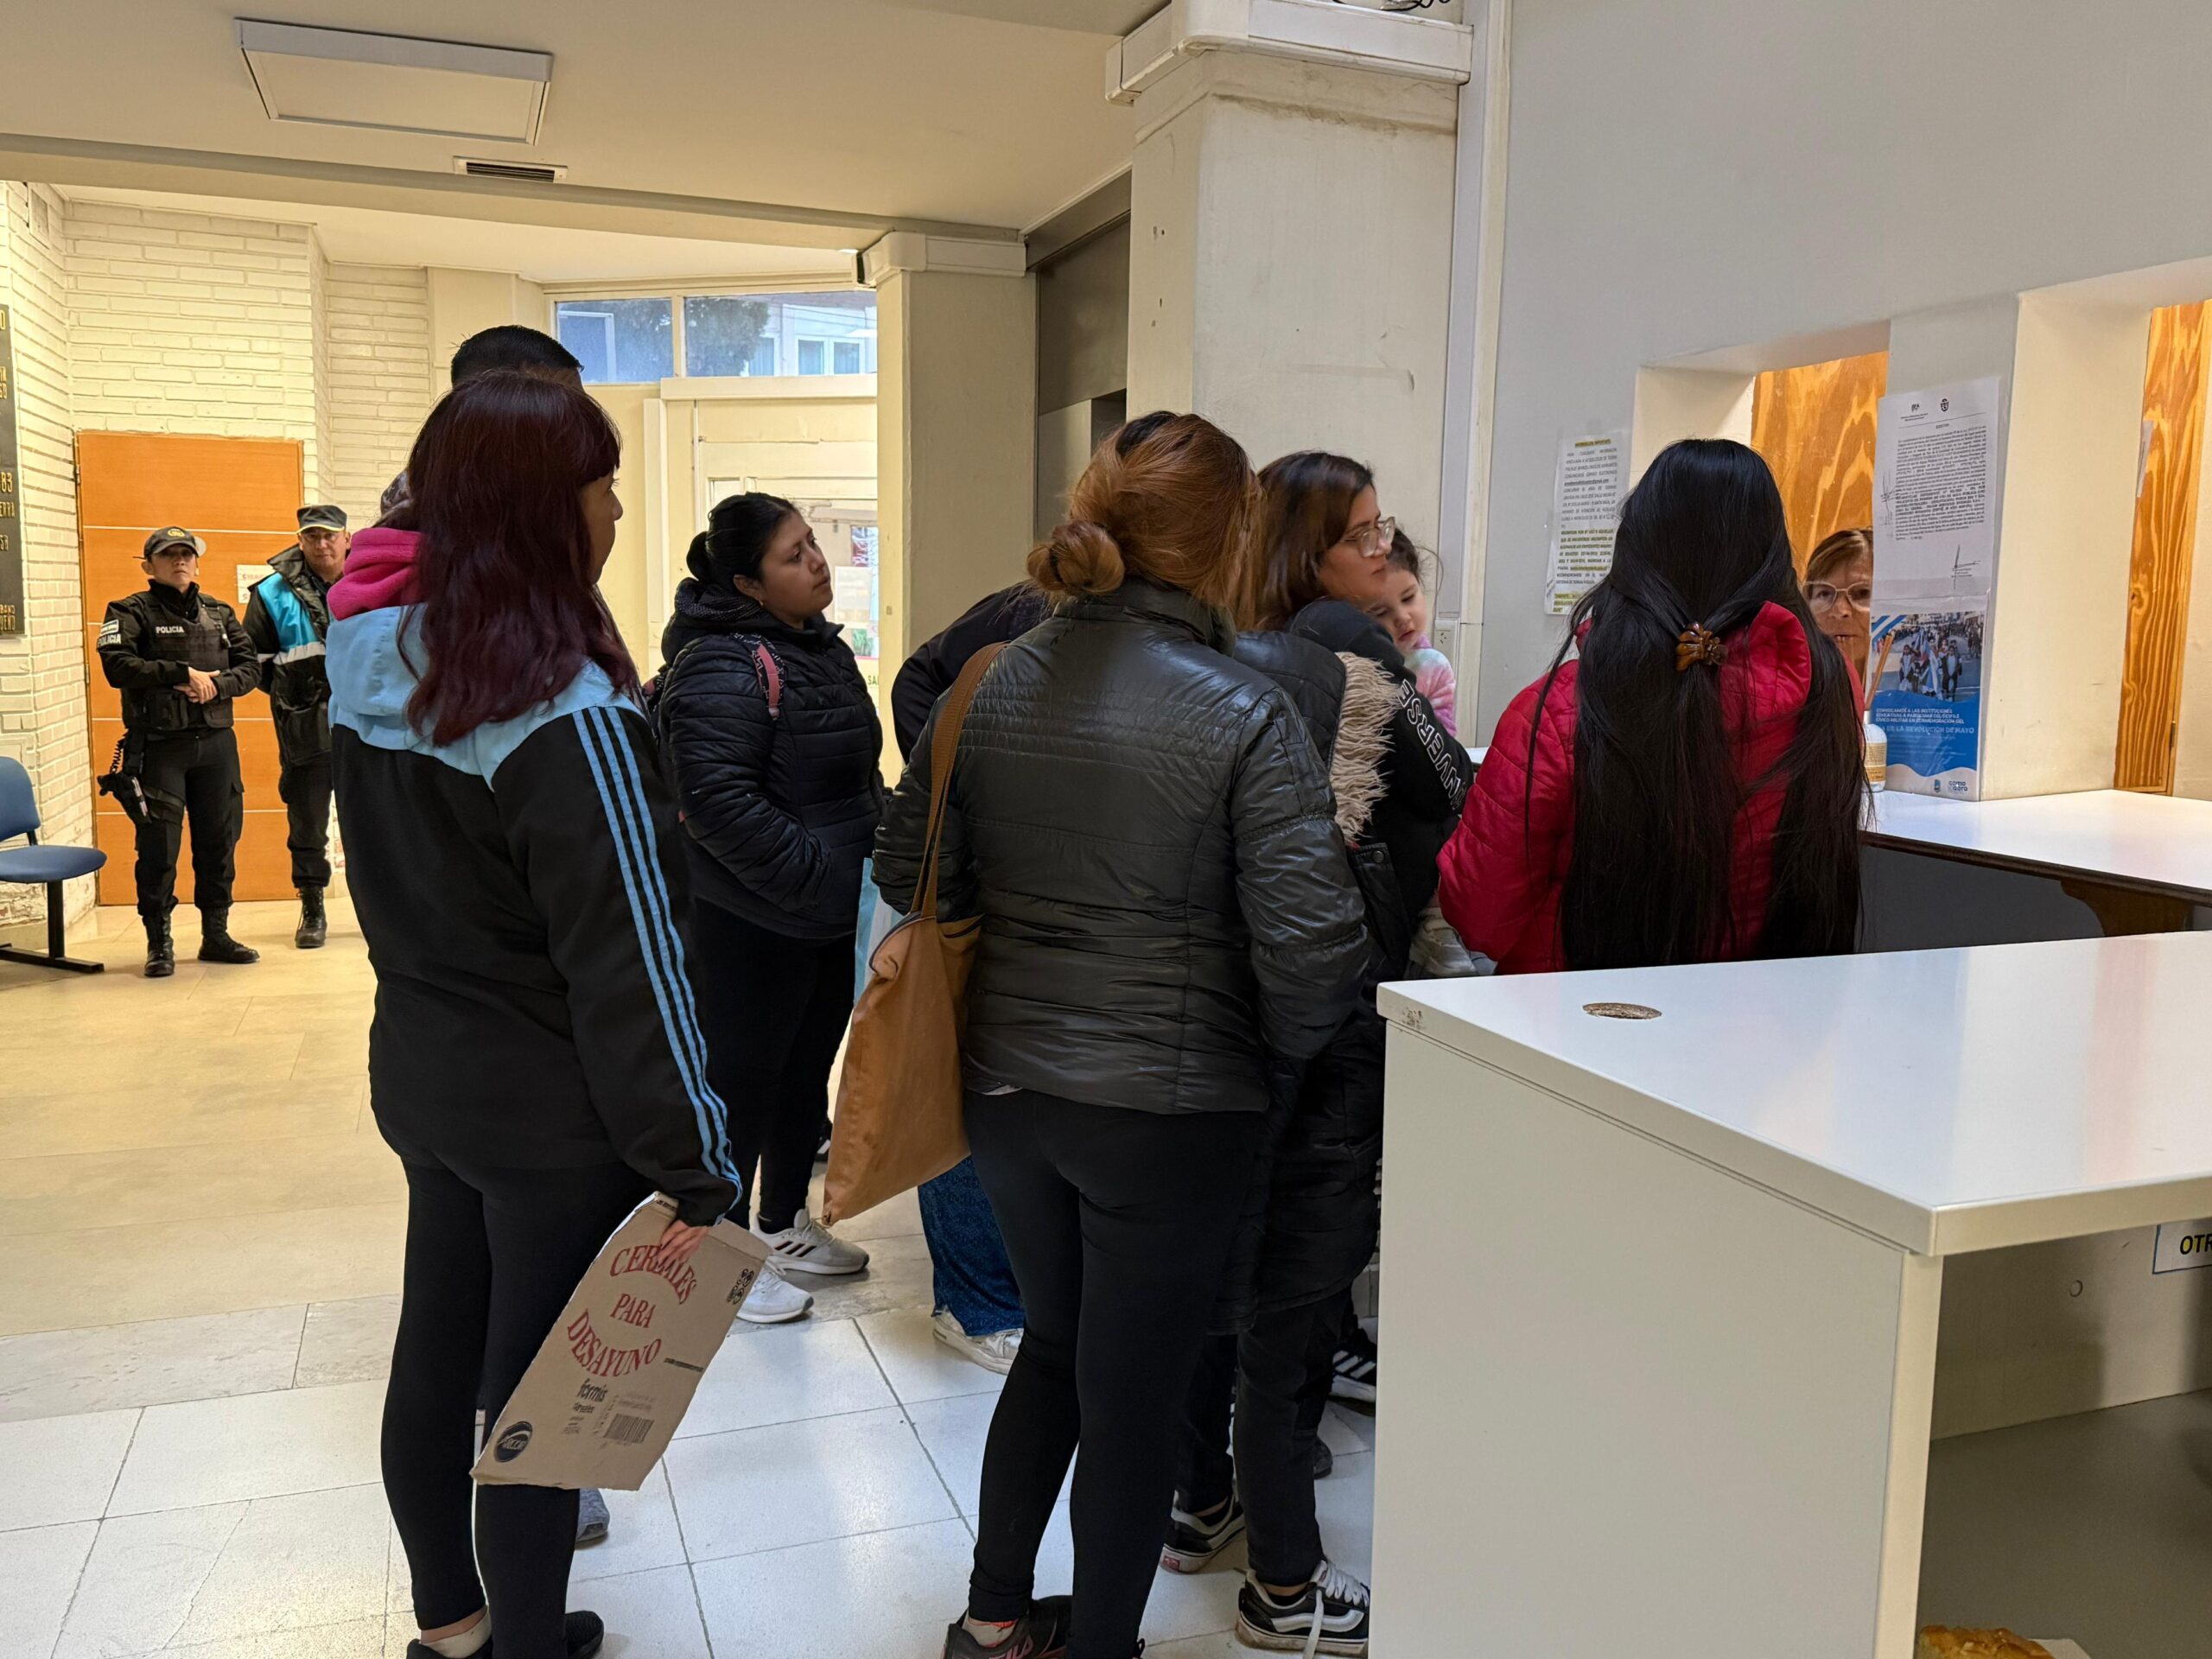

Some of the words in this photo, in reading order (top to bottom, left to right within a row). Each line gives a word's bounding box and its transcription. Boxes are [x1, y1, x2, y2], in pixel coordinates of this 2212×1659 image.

[97, 633, 121, 647] POLICIA
[156, 626, 184, 634] POLICIA
[610, 1294, 656, 1328] PARA
[567, 1307, 662, 1377] DESAYUNO
